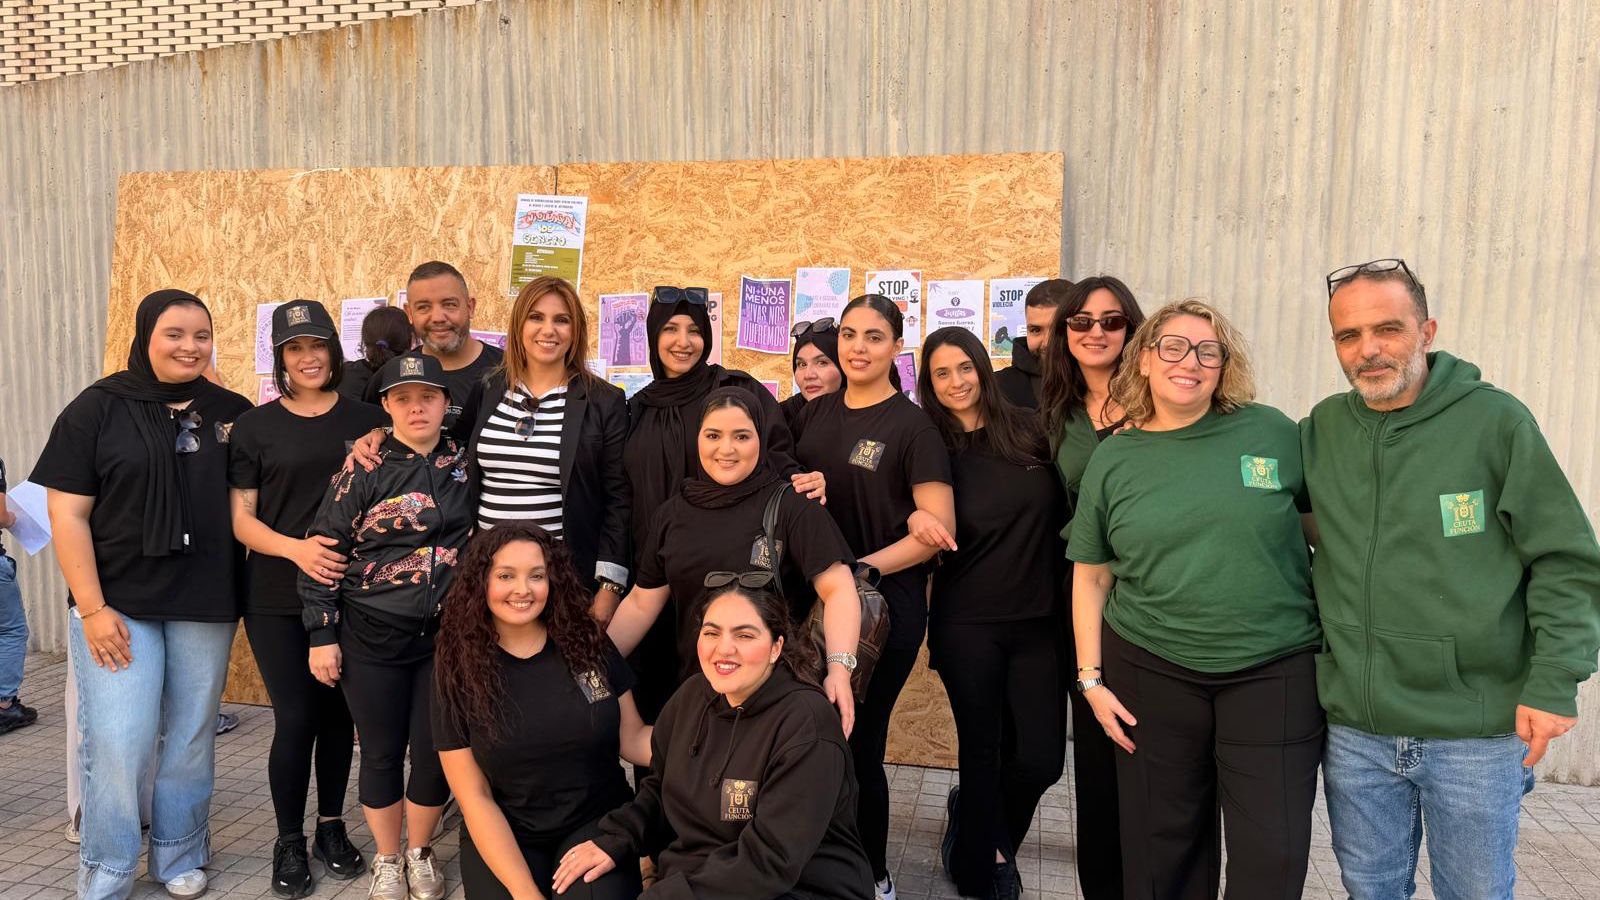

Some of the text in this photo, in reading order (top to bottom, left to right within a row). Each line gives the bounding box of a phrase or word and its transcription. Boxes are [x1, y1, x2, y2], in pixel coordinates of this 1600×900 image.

[878, 280, 909, 297] STOP
[999, 289, 1024, 301] STOP
[745, 293, 785, 305] MENOS
[745, 302, 785, 325] VIVAS NOS
[743, 321, 786, 347] QUEREMOS
